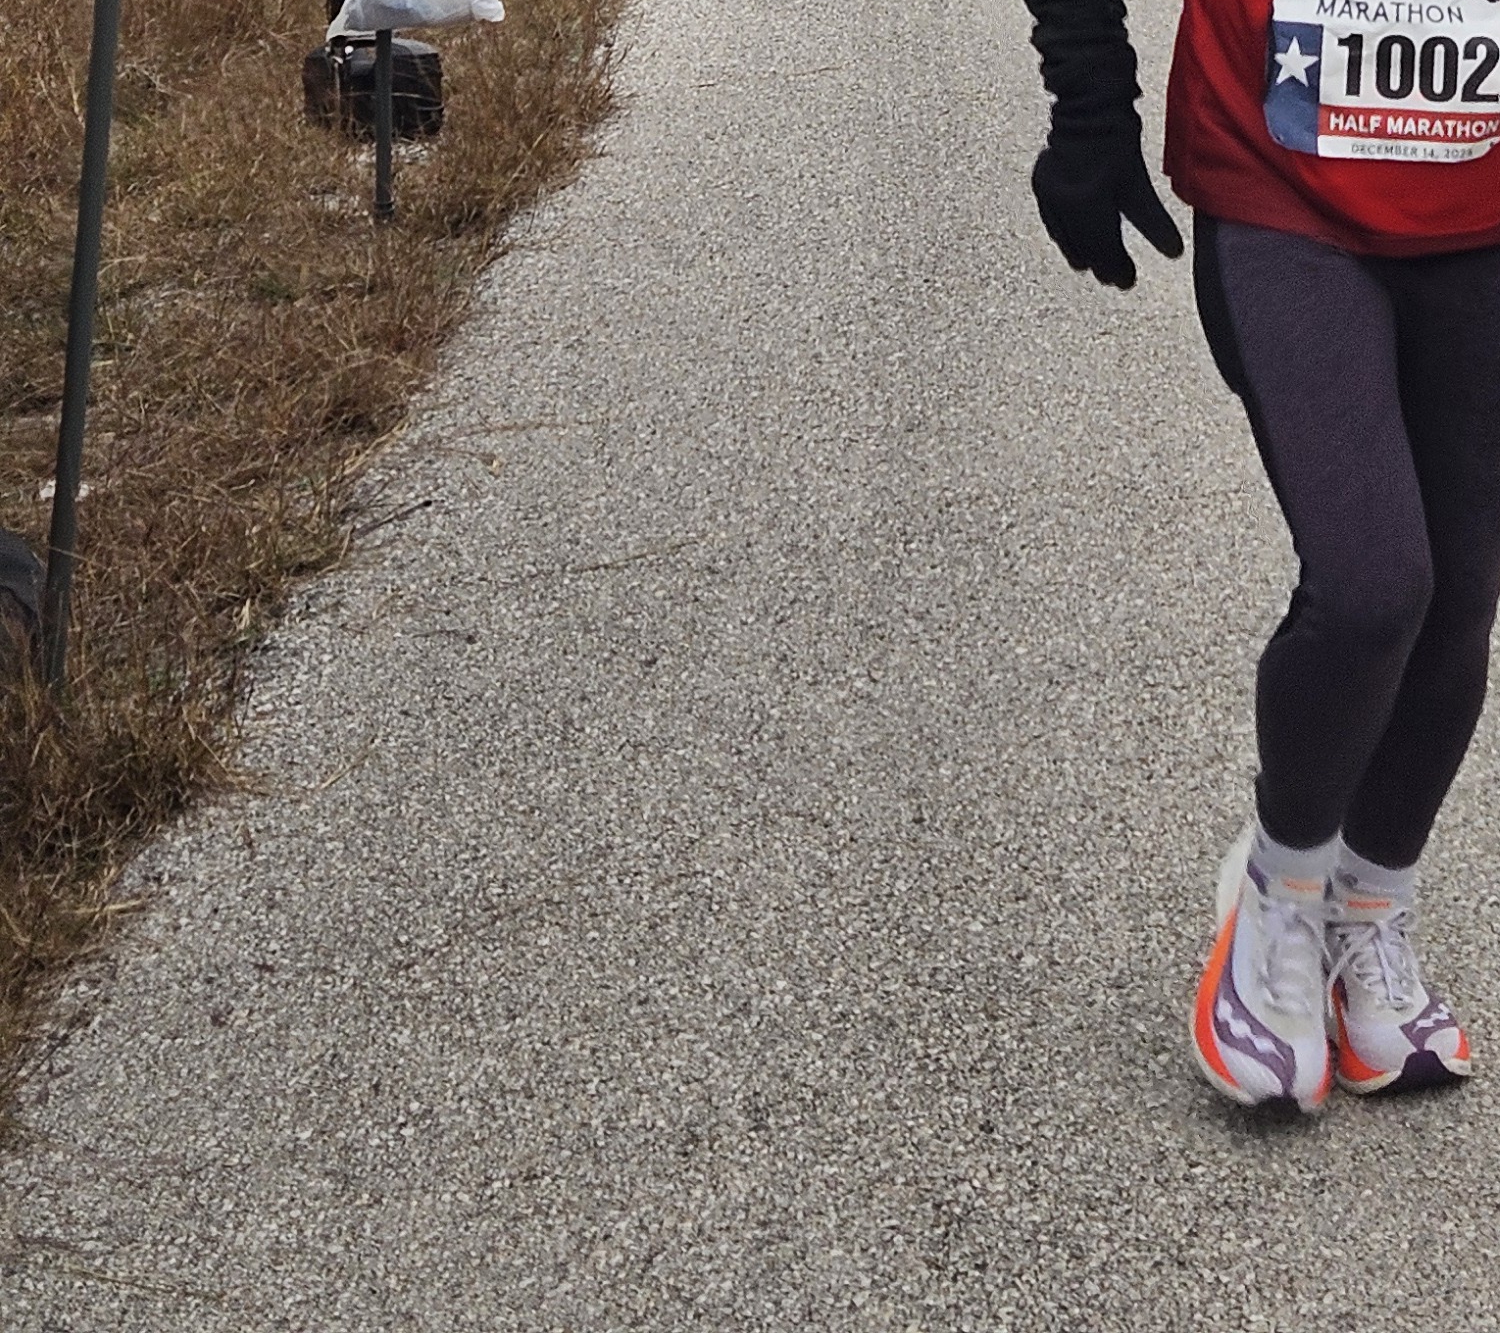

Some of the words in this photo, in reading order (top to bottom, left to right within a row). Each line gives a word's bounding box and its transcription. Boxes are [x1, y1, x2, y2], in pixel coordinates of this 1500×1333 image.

[1337, 33, 1500, 104] 1002
[1329, 111, 1383, 134] HALF
[1387, 115, 1500, 139] MARATHON
